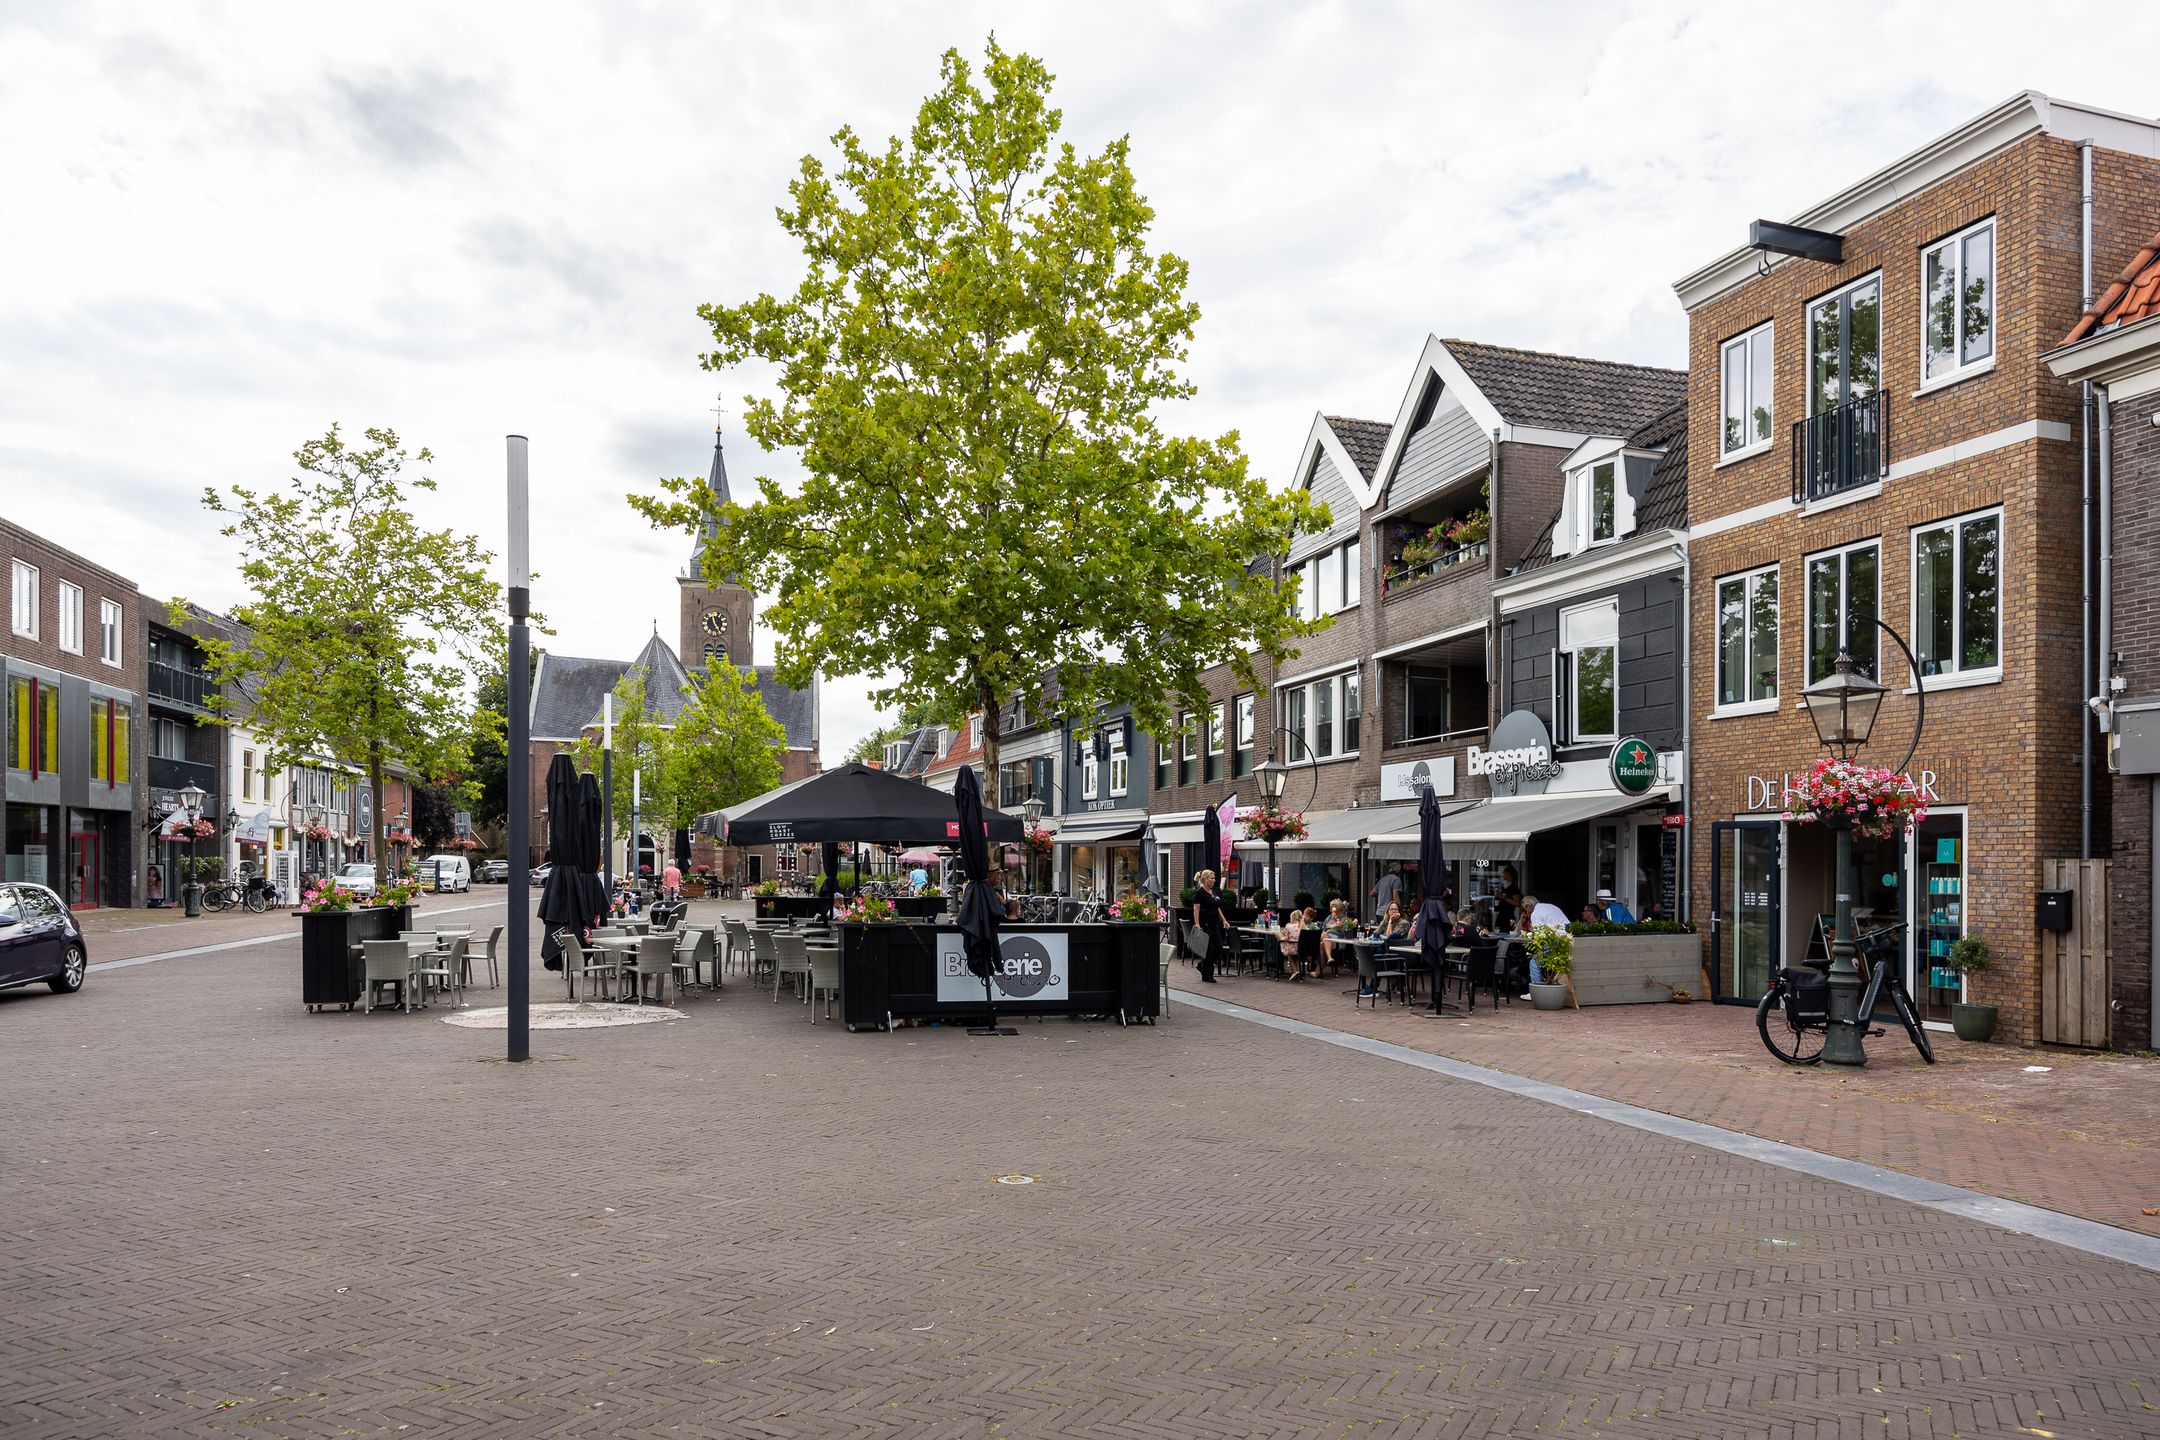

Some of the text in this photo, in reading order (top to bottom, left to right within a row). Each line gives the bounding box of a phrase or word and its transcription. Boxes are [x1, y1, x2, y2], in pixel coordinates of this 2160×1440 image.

[1467, 738, 1549, 776] Brasserie
[1619, 767, 1655, 776] Heineken
[1494, 760, 1562, 795] expreszo
[1748, 776, 1778, 809] DE
[945, 952, 1043, 977] Brerie
